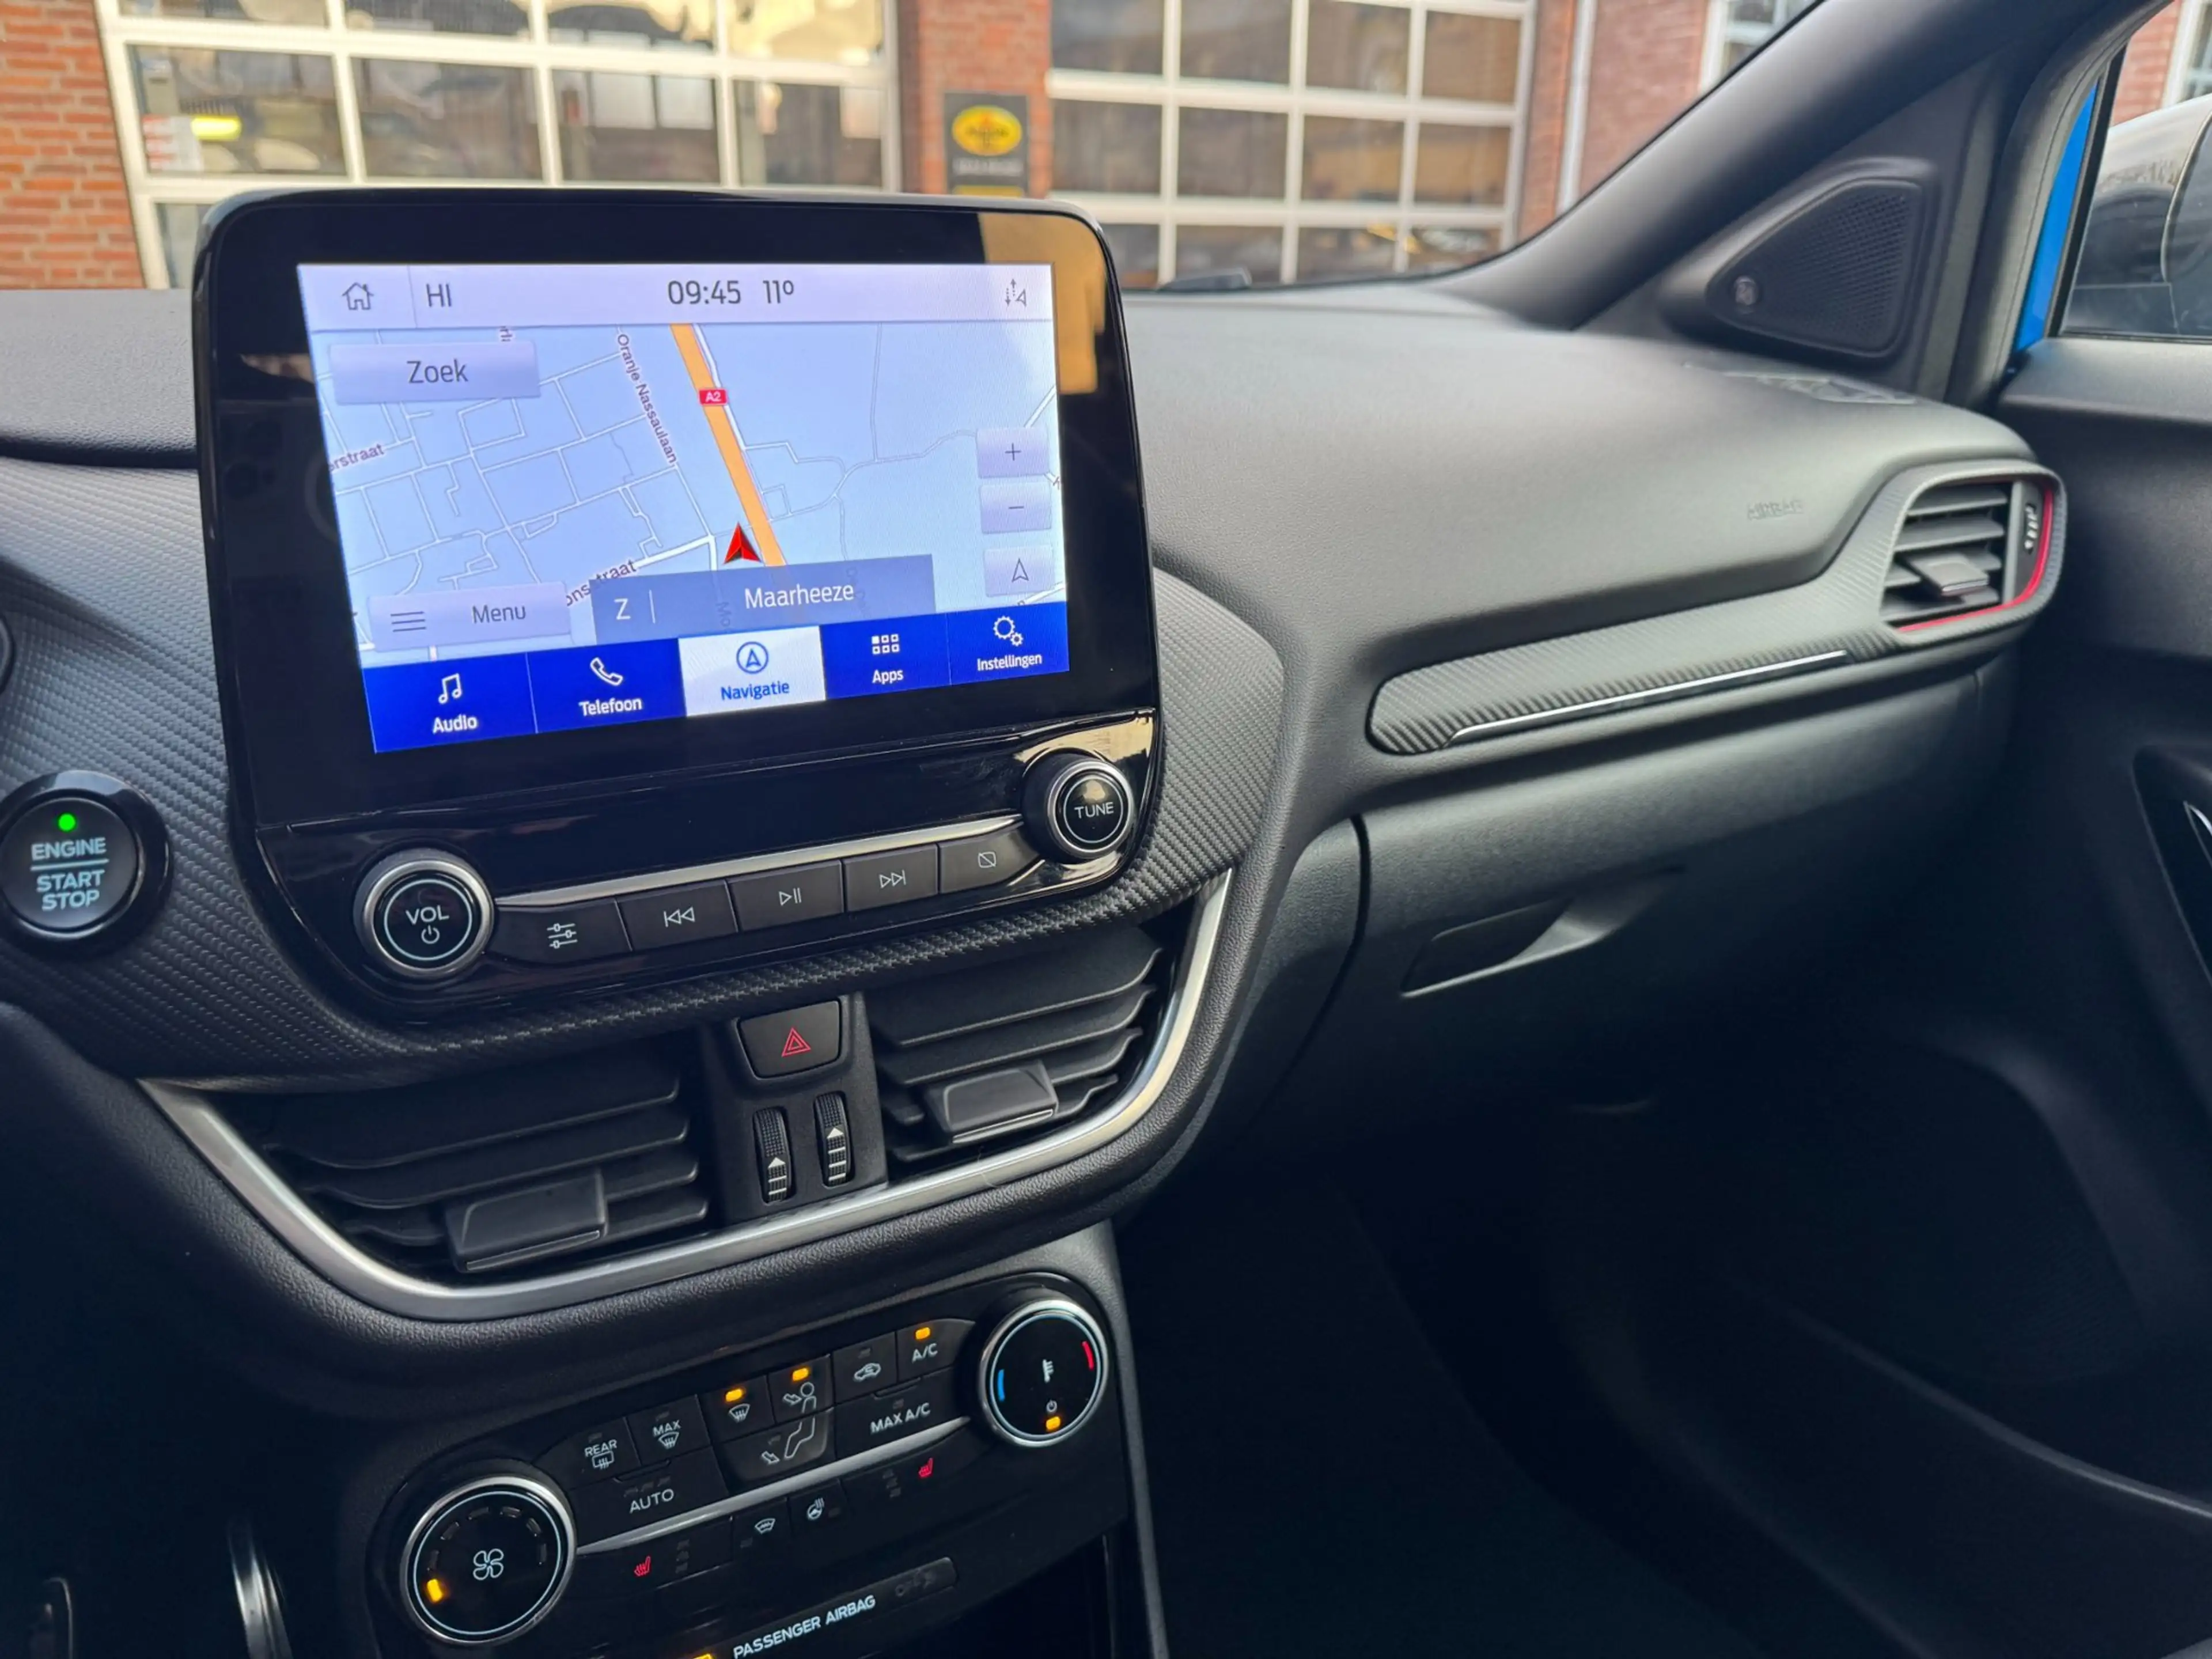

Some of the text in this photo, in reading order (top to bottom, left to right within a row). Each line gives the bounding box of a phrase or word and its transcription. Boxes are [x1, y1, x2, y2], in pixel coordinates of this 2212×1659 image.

[426, 283, 452, 308] HI
[668, 279, 741, 305] 09:45
[407, 359, 468, 384] Zoek
[617, 334, 677, 464] Oranje Nassaulaan
[704, 391, 721, 402] A2
[613, 598, 631, 620] Z
[744, 582, 854, 609] Maarheeze
[471, 604, 527, 624] Menu
[977, 652, 1043, 672] Instellingen
[872, 668, 904, 685] Apps
[721, 680, 790, 701] Navigatie
[578, 698, 642, 717] Telefoon
[432, 714, 479, 734] Audio
[1074, 802, 1114, 819] TUNE
[32, 838, 107, 861] ENGINE
[36, 869, 105, 892] START
[41, 890, 100, 911] STOP
[405, 905, 449, 925] VOL
[912, 1343, 938, 1362] A/C
[653, 1420, 681, 1437] MAX
[870, 1402, 930, 1434] MAX A/C
[585, 1439, 618, 1457] REAR
[629, 1488, 674, 1514] AUTO
[733, 1595, 876, 1659] PASSENGER AIRBAG
